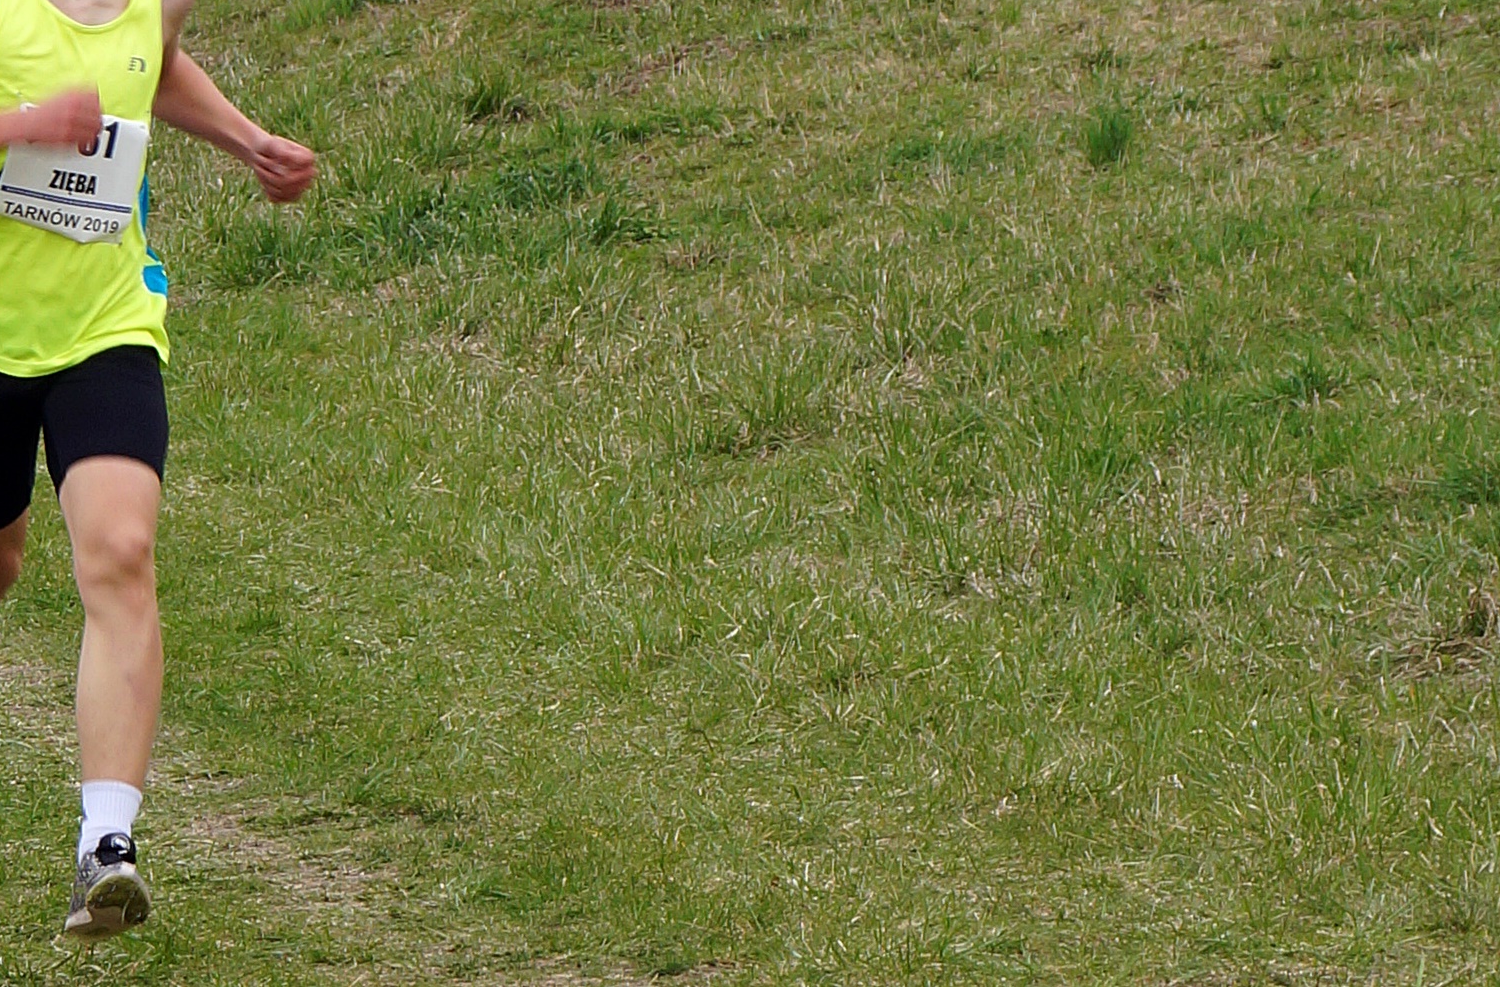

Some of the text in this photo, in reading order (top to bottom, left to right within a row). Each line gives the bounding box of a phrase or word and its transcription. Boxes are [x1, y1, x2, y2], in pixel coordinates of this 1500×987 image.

[49, 169, 97, 196] ZIĘBA
[4, 202, 119, 234] TARNÓW 2019
